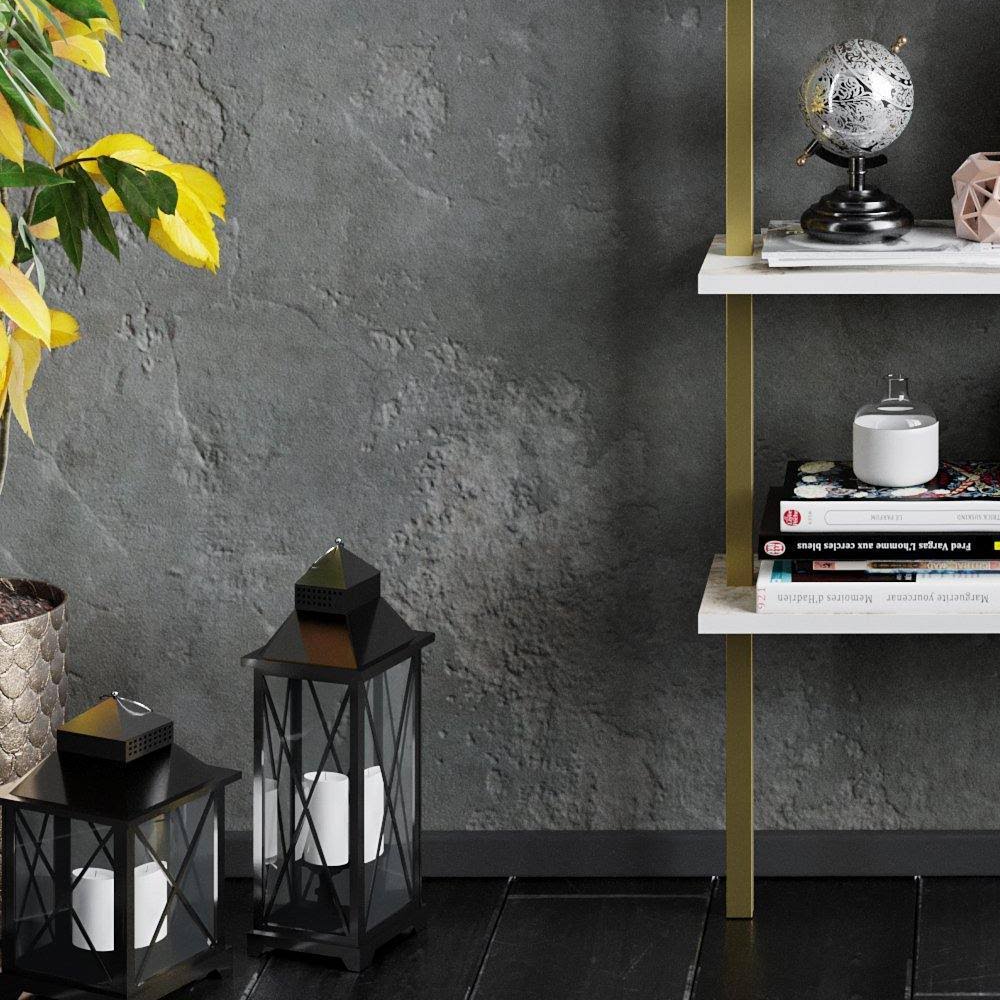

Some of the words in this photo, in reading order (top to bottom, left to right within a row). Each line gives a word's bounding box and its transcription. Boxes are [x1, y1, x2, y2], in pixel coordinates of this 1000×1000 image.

[797, 542, 820, 551] bleus
[823, 542, 855, 551] cercles
[876, 542, 916, 551] L'homme
[919, 541, 949, 551] Vargas
[951, 541, 971, 551] Fred
[777, 593, 825, 604] d'Hadrien
[826, 593, 873, 604] Memoires
[886, 592, 935, 602] yourcenar
[936, 592, 989, 603] Marguerite
